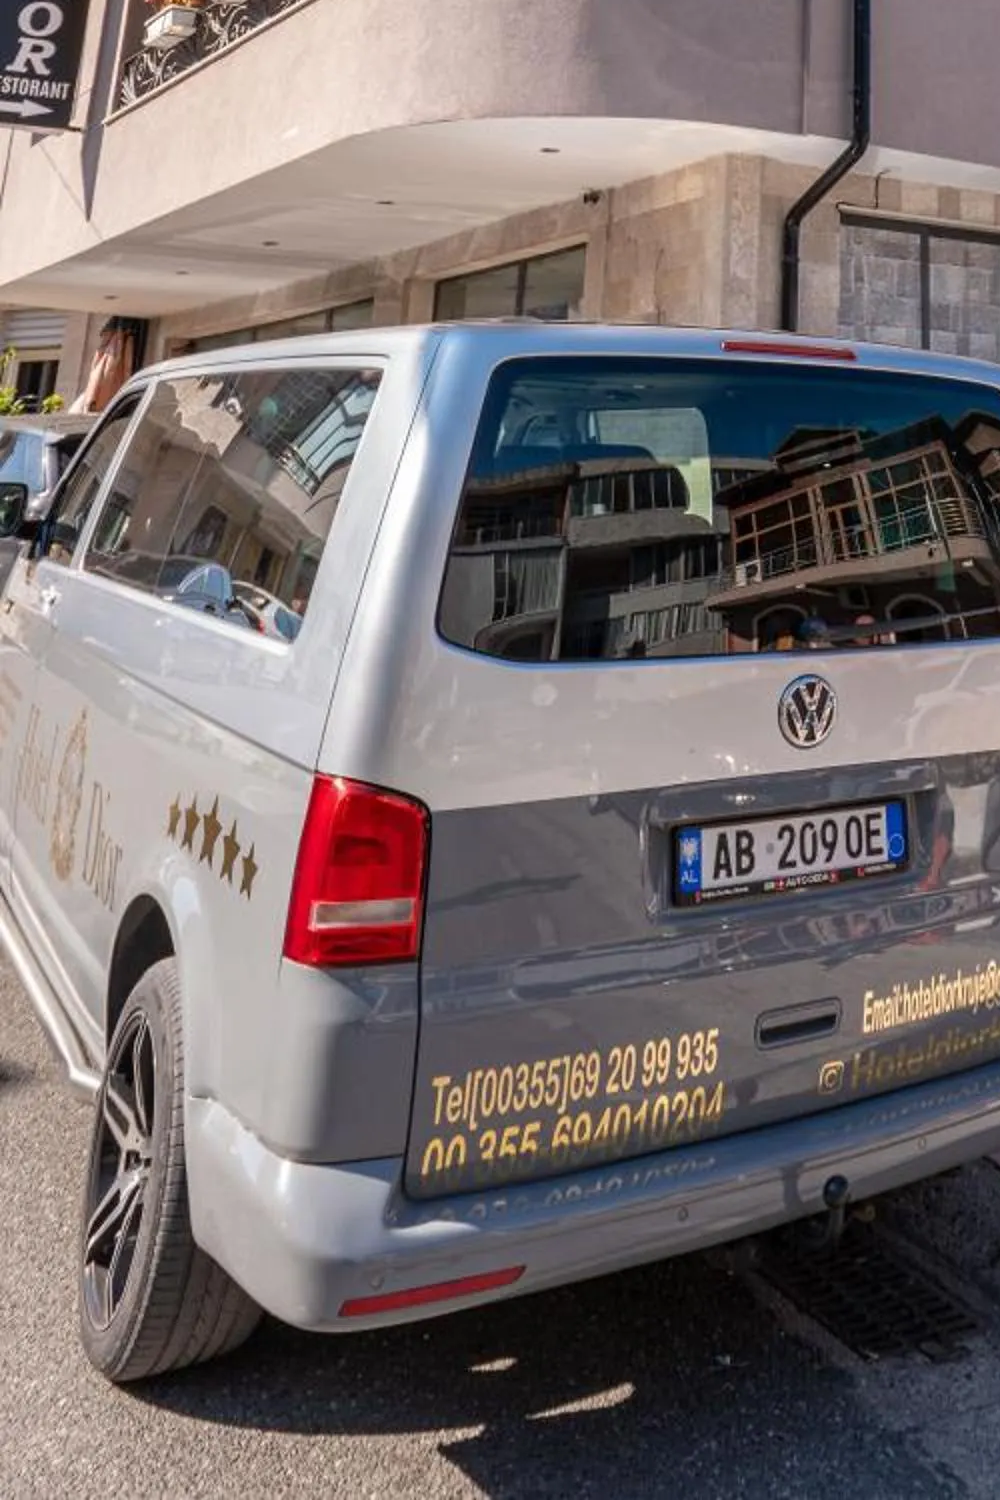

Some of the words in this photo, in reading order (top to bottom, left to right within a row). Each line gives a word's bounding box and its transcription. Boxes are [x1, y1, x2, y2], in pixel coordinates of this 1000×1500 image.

[0, 74, 71, 100] STORANT
[712, 830, 756, 881] AB
[606, 1044, 637, 1094] 20
[642, 1037, 671, 1088] 99
[676, 1028, 720, 1080] 935
